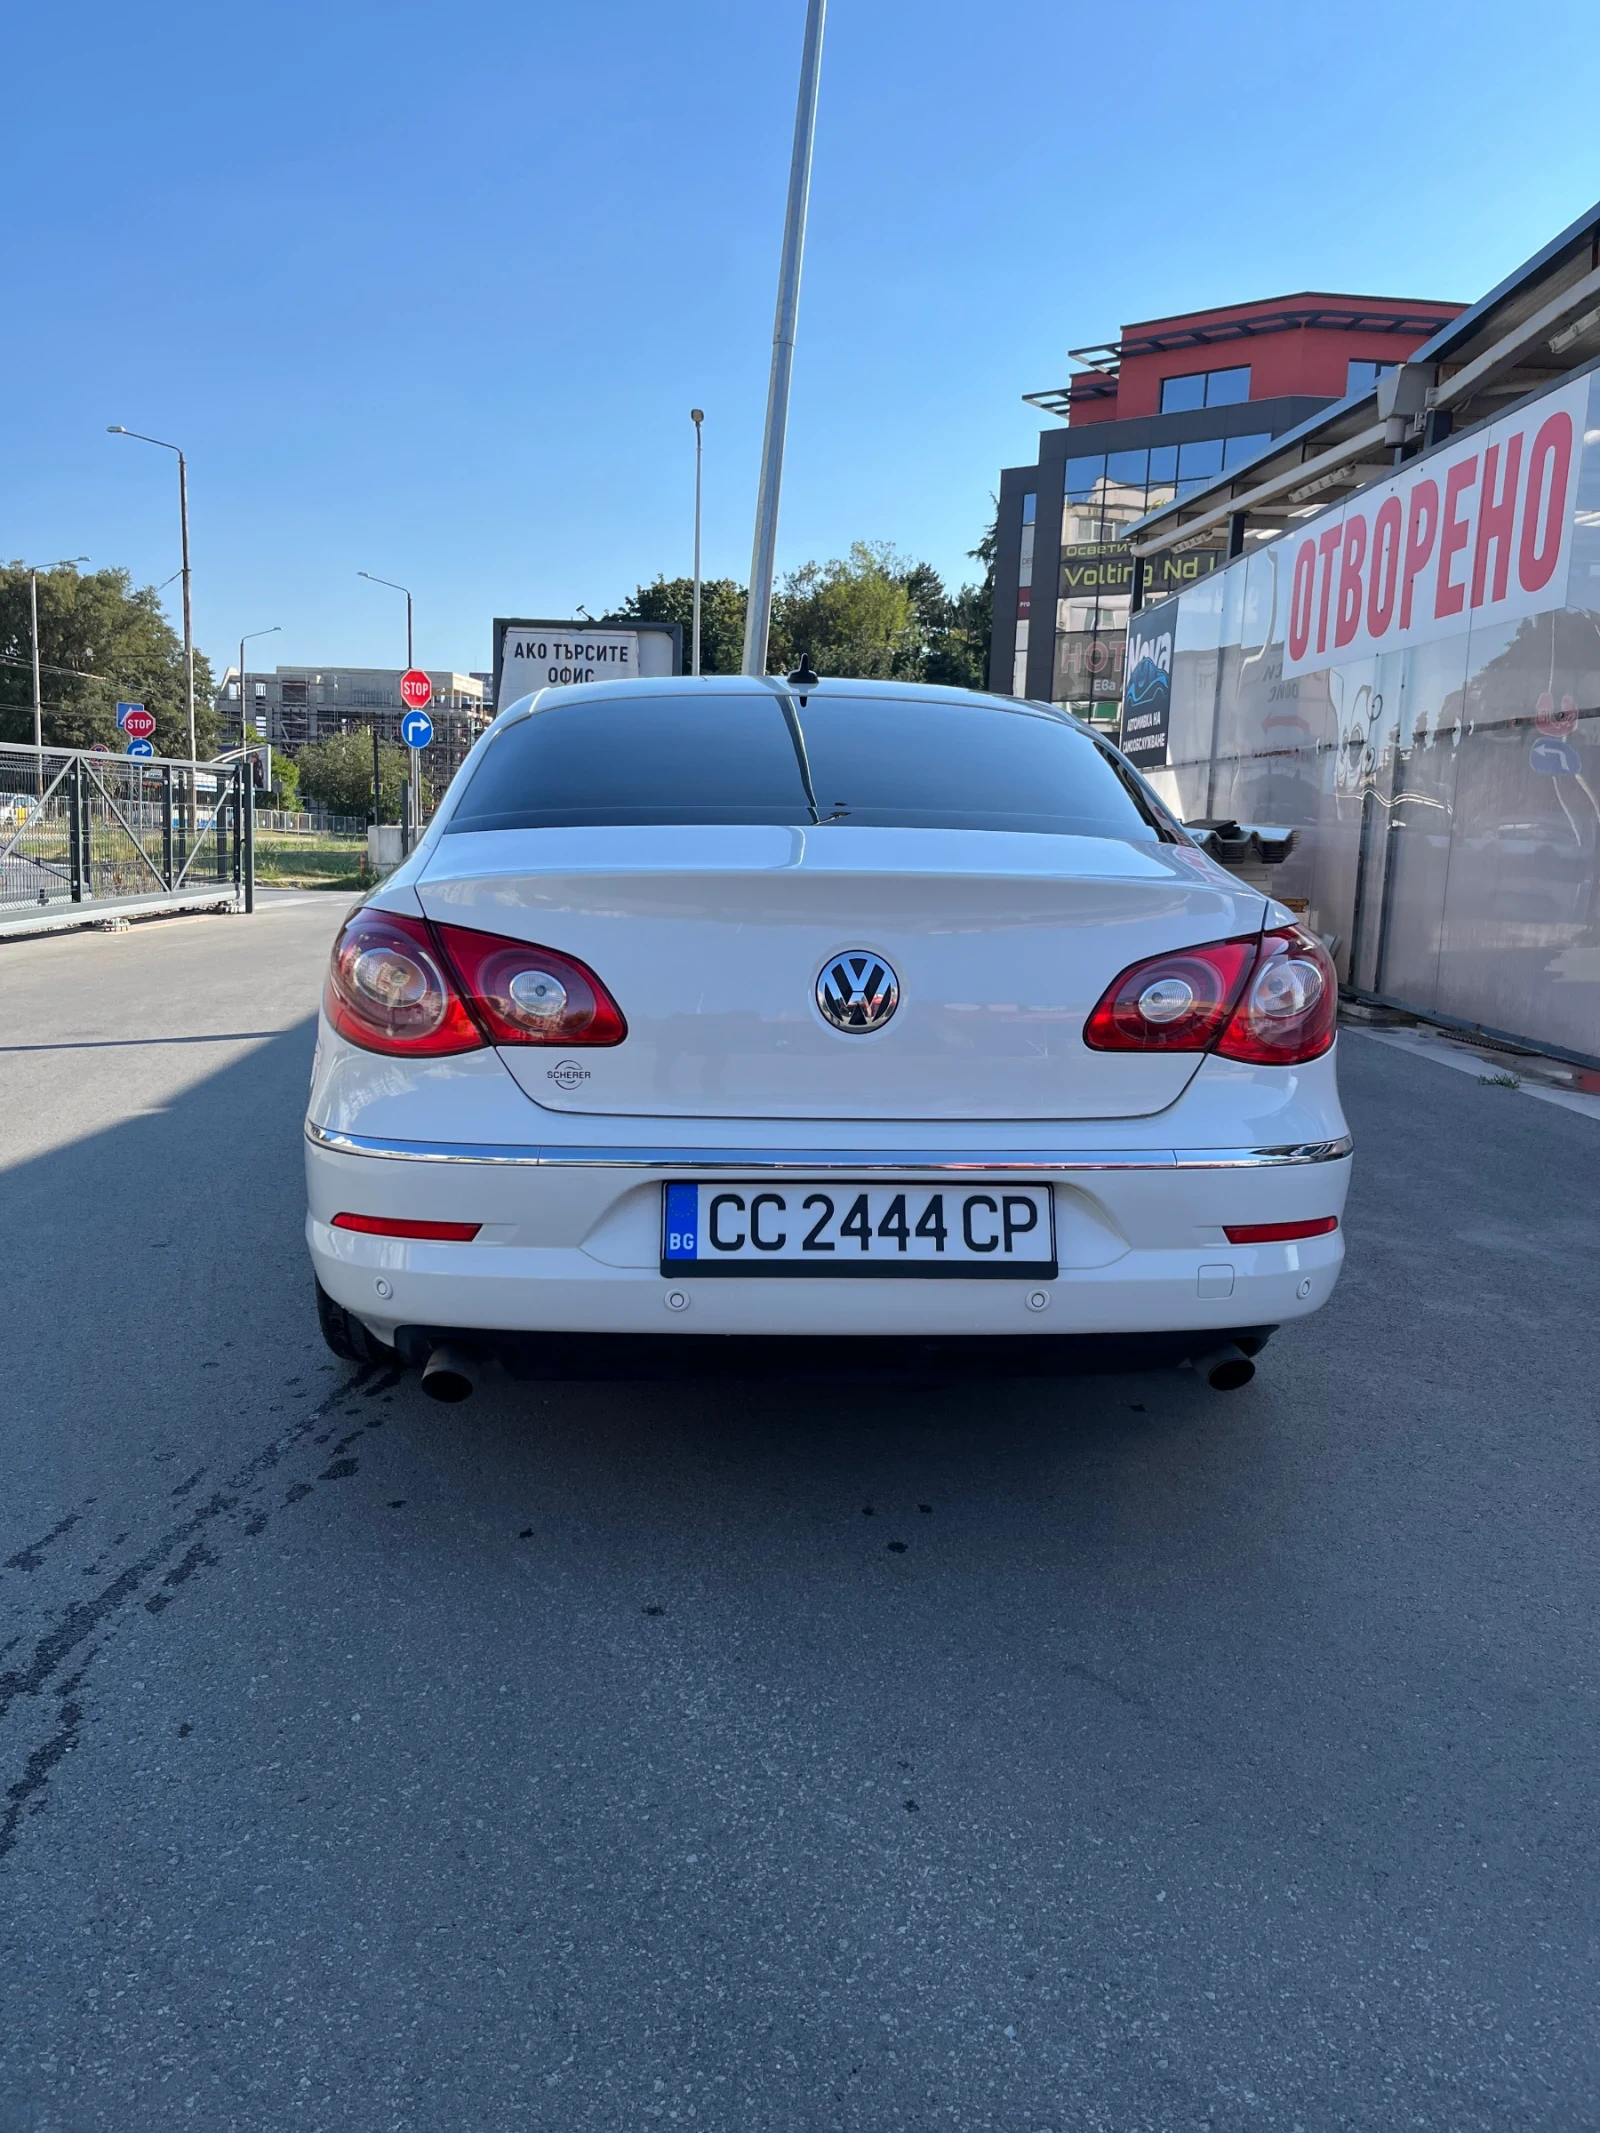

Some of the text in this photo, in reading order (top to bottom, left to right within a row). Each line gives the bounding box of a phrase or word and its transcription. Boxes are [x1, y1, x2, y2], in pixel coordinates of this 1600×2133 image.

[1289, 411, 1573, 662] ОТВОРЕНО
[1163, 556, 1199, 580] Nd
[514, 642, 629, 662] АКО ТЪРСИТЕ
[548, 666, 595, 685] ОФИС
[403, 681, 429, 696] STOP
[127, 719, 152, 730] STOP
[546, 1070, 591, 1079] SCHERER
[709, 1193, 1038, 1253] CC 2444 CP
[669, 1232, 695, 1251] BG
